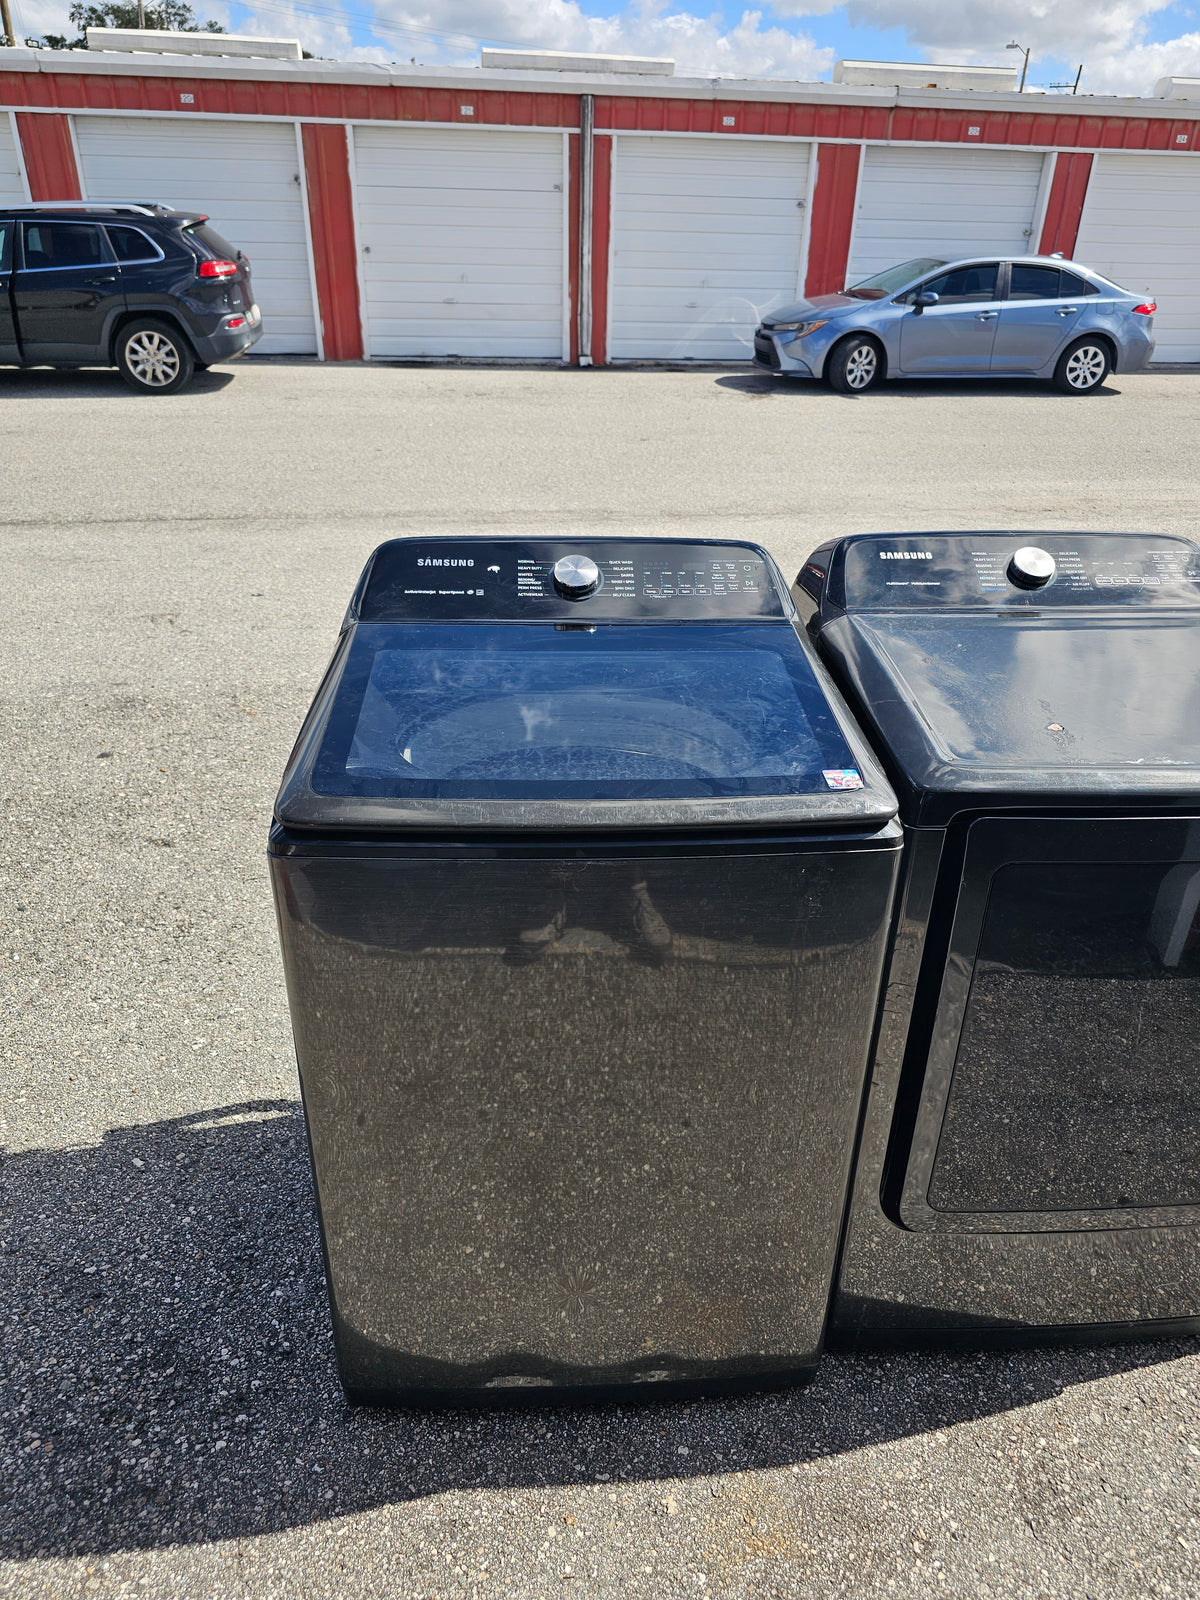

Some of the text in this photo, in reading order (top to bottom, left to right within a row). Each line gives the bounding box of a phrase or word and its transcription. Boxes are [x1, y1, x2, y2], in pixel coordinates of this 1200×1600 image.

[182, 94, 193, 103] 20
[879, 552, 933, 560] SAMSUNG
[416, 558, 475, 567] SAMSUNG
